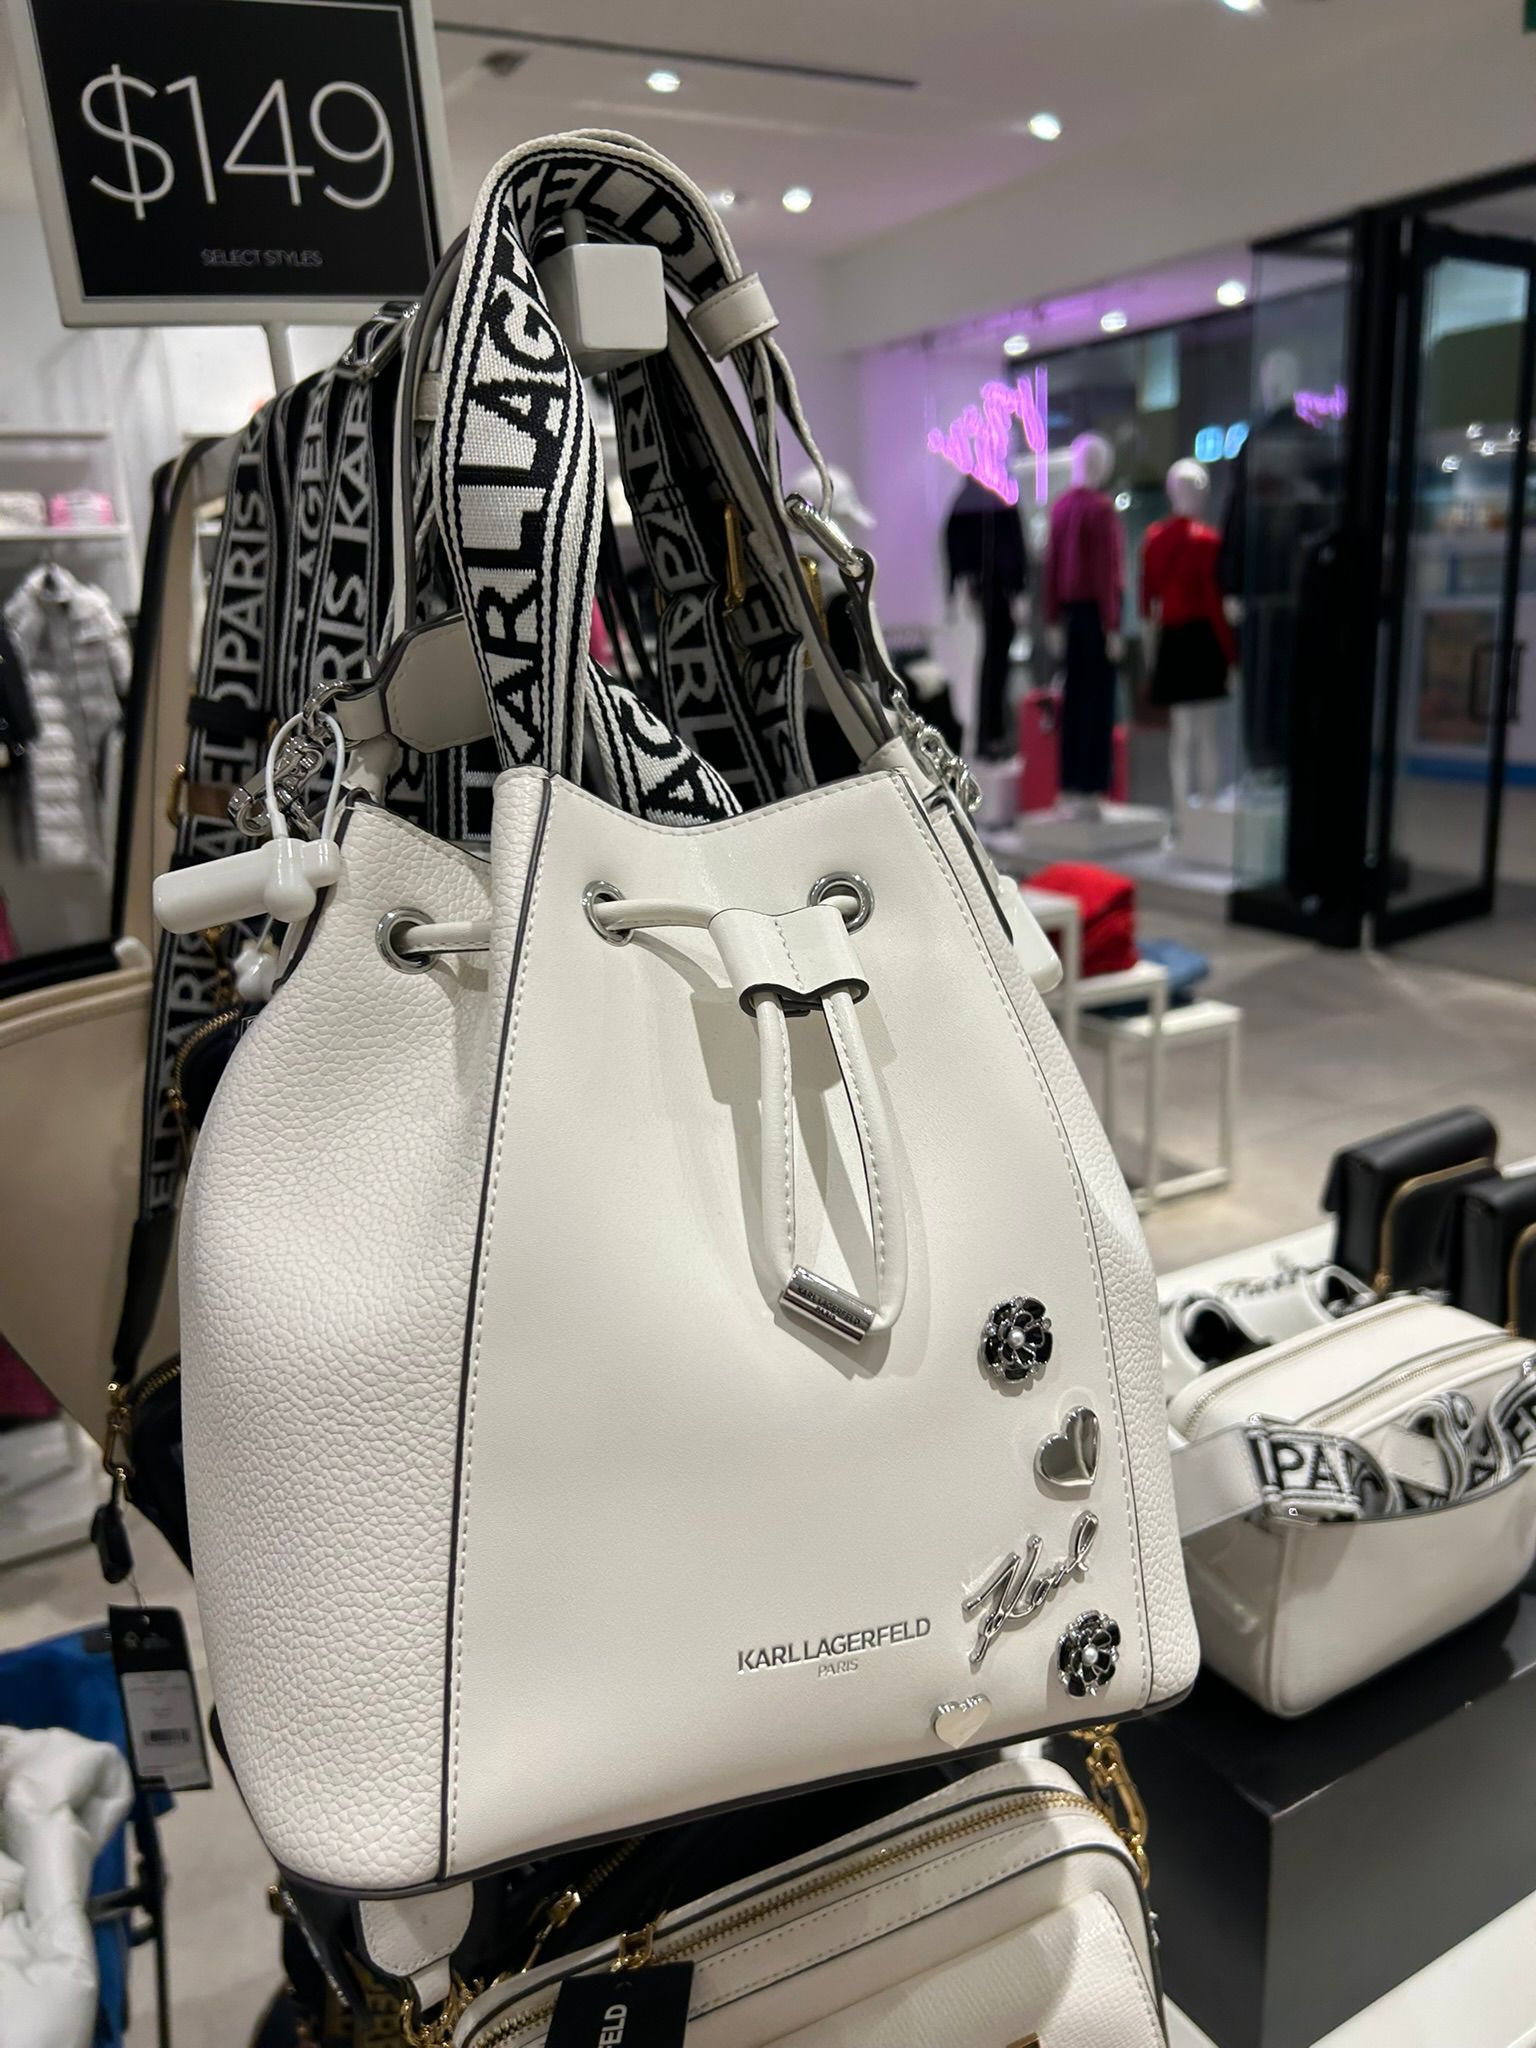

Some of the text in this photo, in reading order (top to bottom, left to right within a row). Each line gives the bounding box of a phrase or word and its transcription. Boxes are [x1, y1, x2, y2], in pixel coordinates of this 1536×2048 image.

[81, 64, 395, 221] $149
[200, 248, 324, 267] SELECT STYLES
[330, 383, 370, 546] KAR
[210, 488, 268, 674] PARIS
[796, 1285, 861, 1325] KARL LAGERFELD
[737, 1616, 932, 1673] KARL LAGERFELD
[817, 1658, 860, 1679] PARIS
